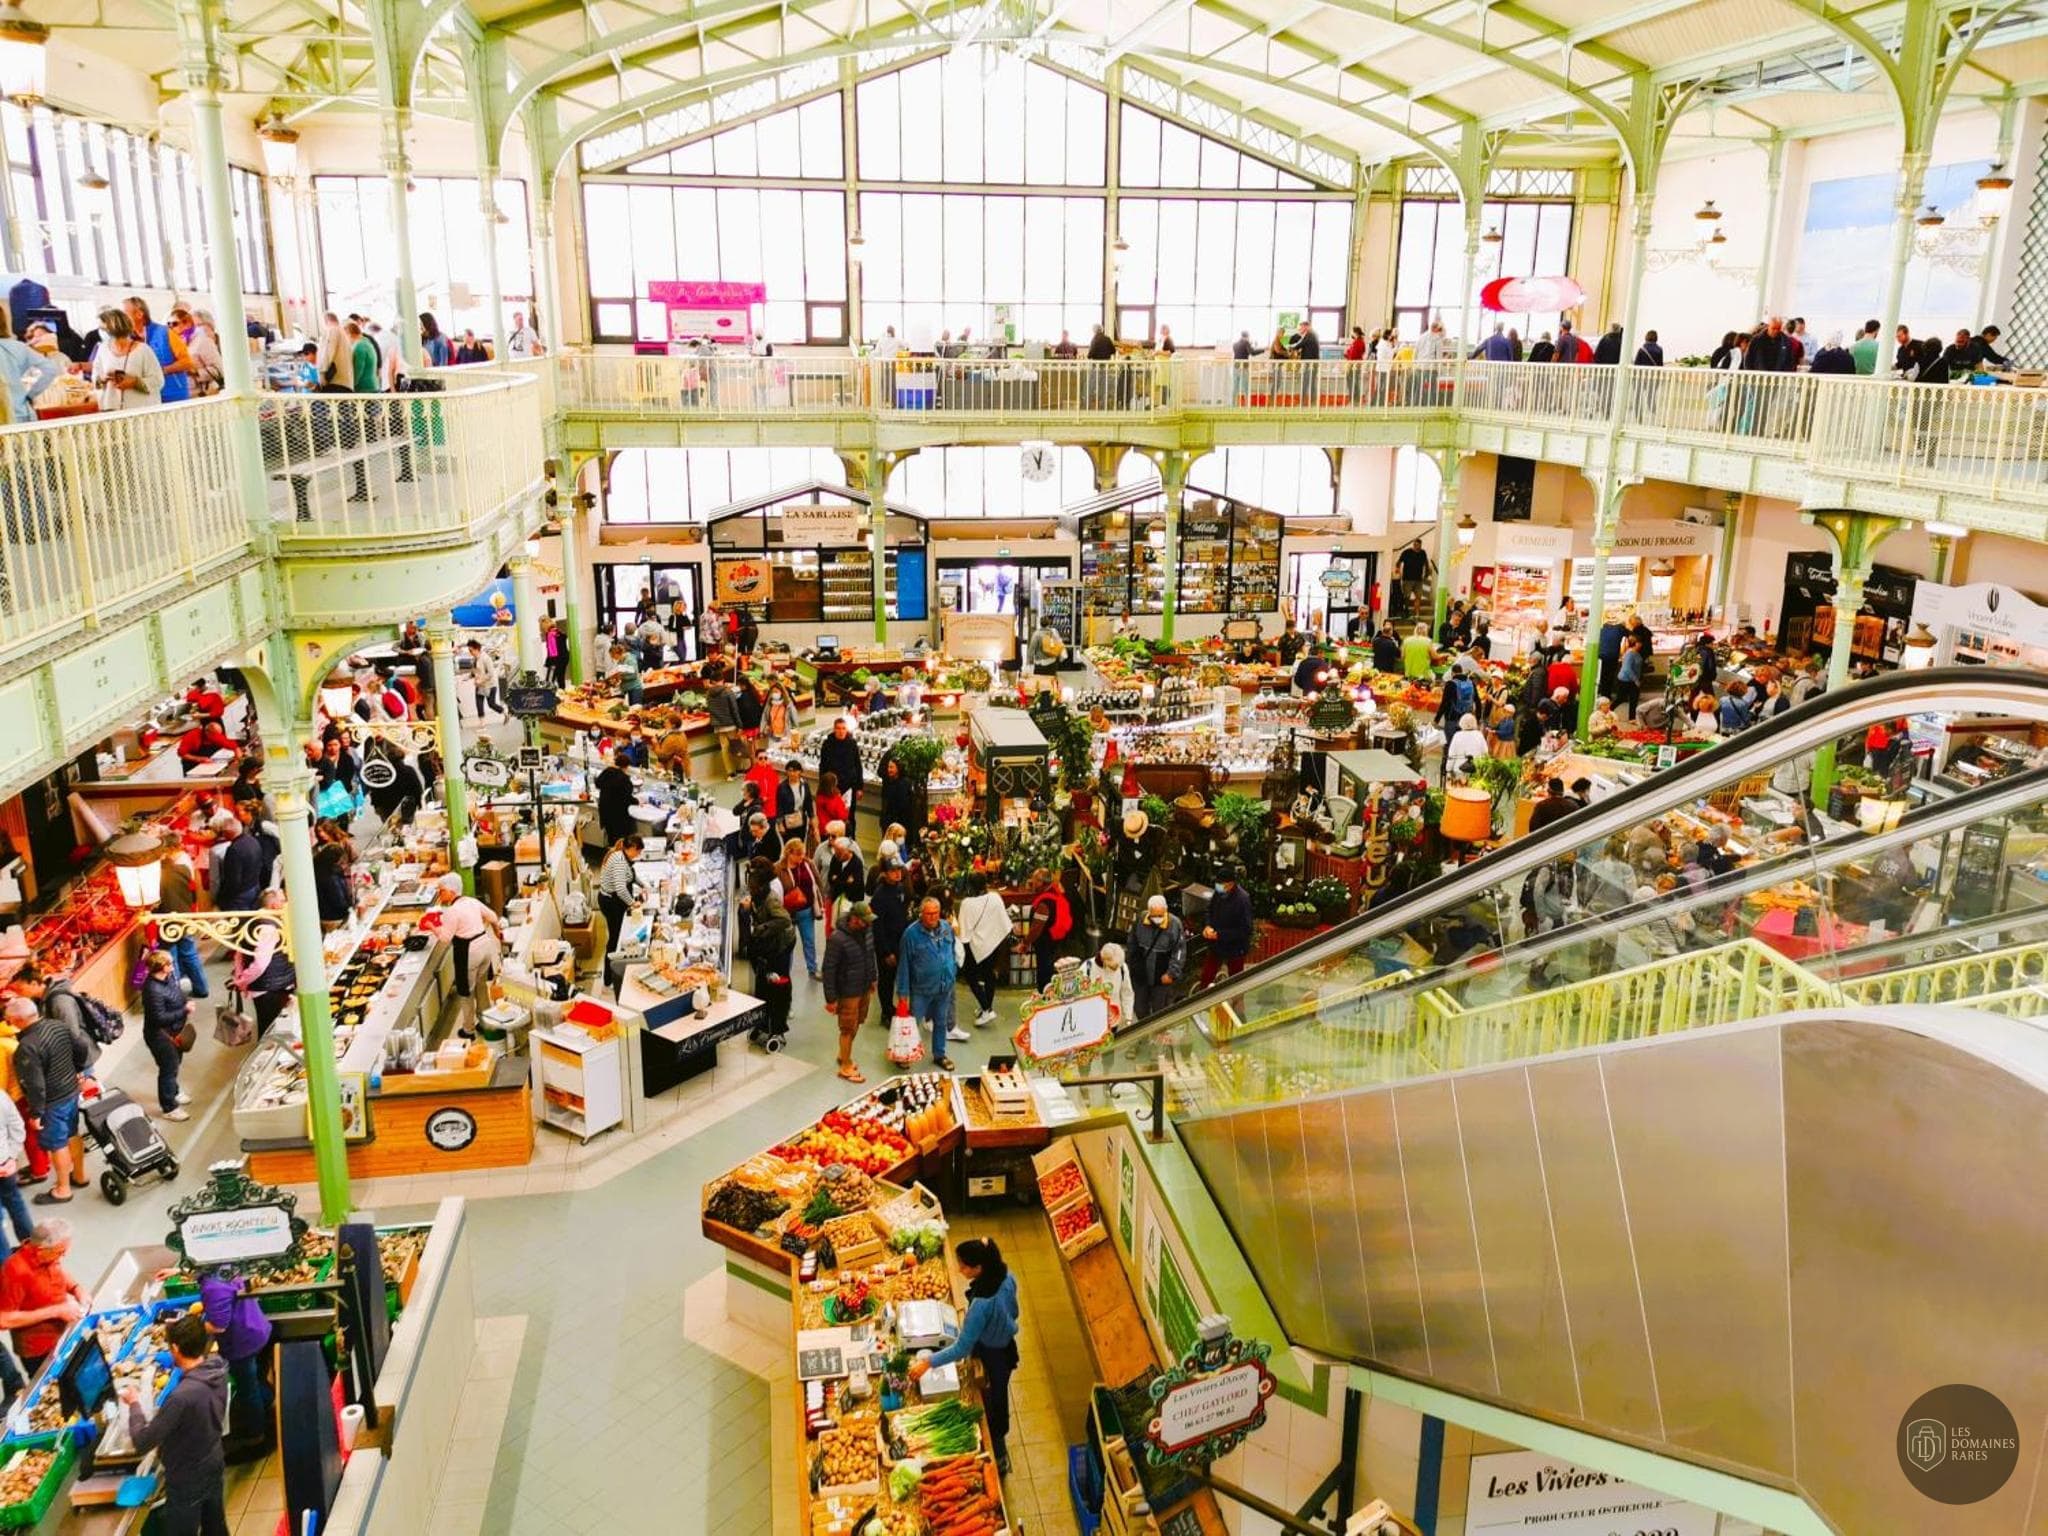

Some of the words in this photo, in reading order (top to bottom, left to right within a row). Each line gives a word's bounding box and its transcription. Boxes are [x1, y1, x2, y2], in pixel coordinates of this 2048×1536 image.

[1654, 534, 1696, 547] FROMAGE
[1172, 1404, 1200, 1421] CHEZ
[1201, 1388, 1249, 1411] GAYLORD
[1487, 1475, 1529, 1499] Les
[1535, 1466, 1608, 1493] Viviers
